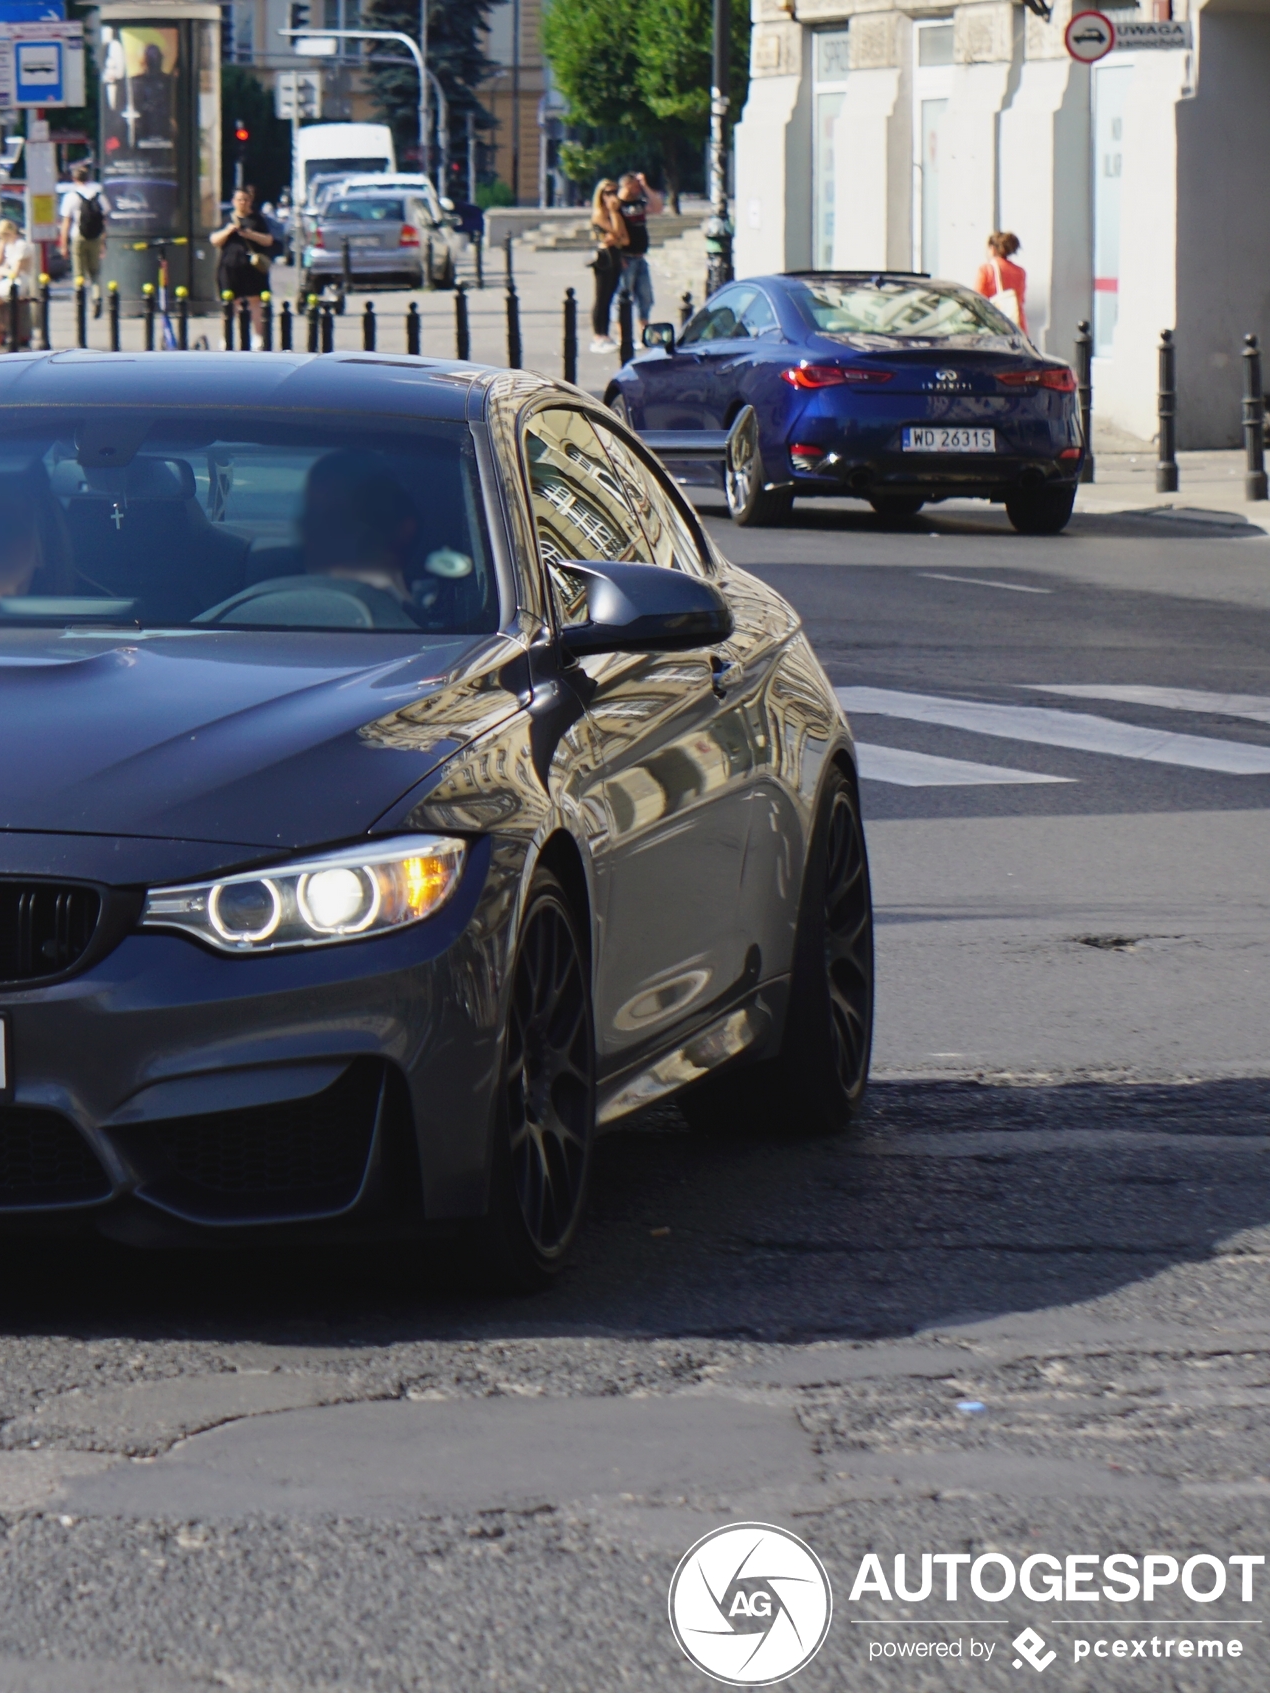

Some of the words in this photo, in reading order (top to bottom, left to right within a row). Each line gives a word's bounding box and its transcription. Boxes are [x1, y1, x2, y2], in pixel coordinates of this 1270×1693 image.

[1117, 25, 1184, 36] UWAGA
[913, 431, 934, 447] WD
[941, 431, 991, 448] 2631S
